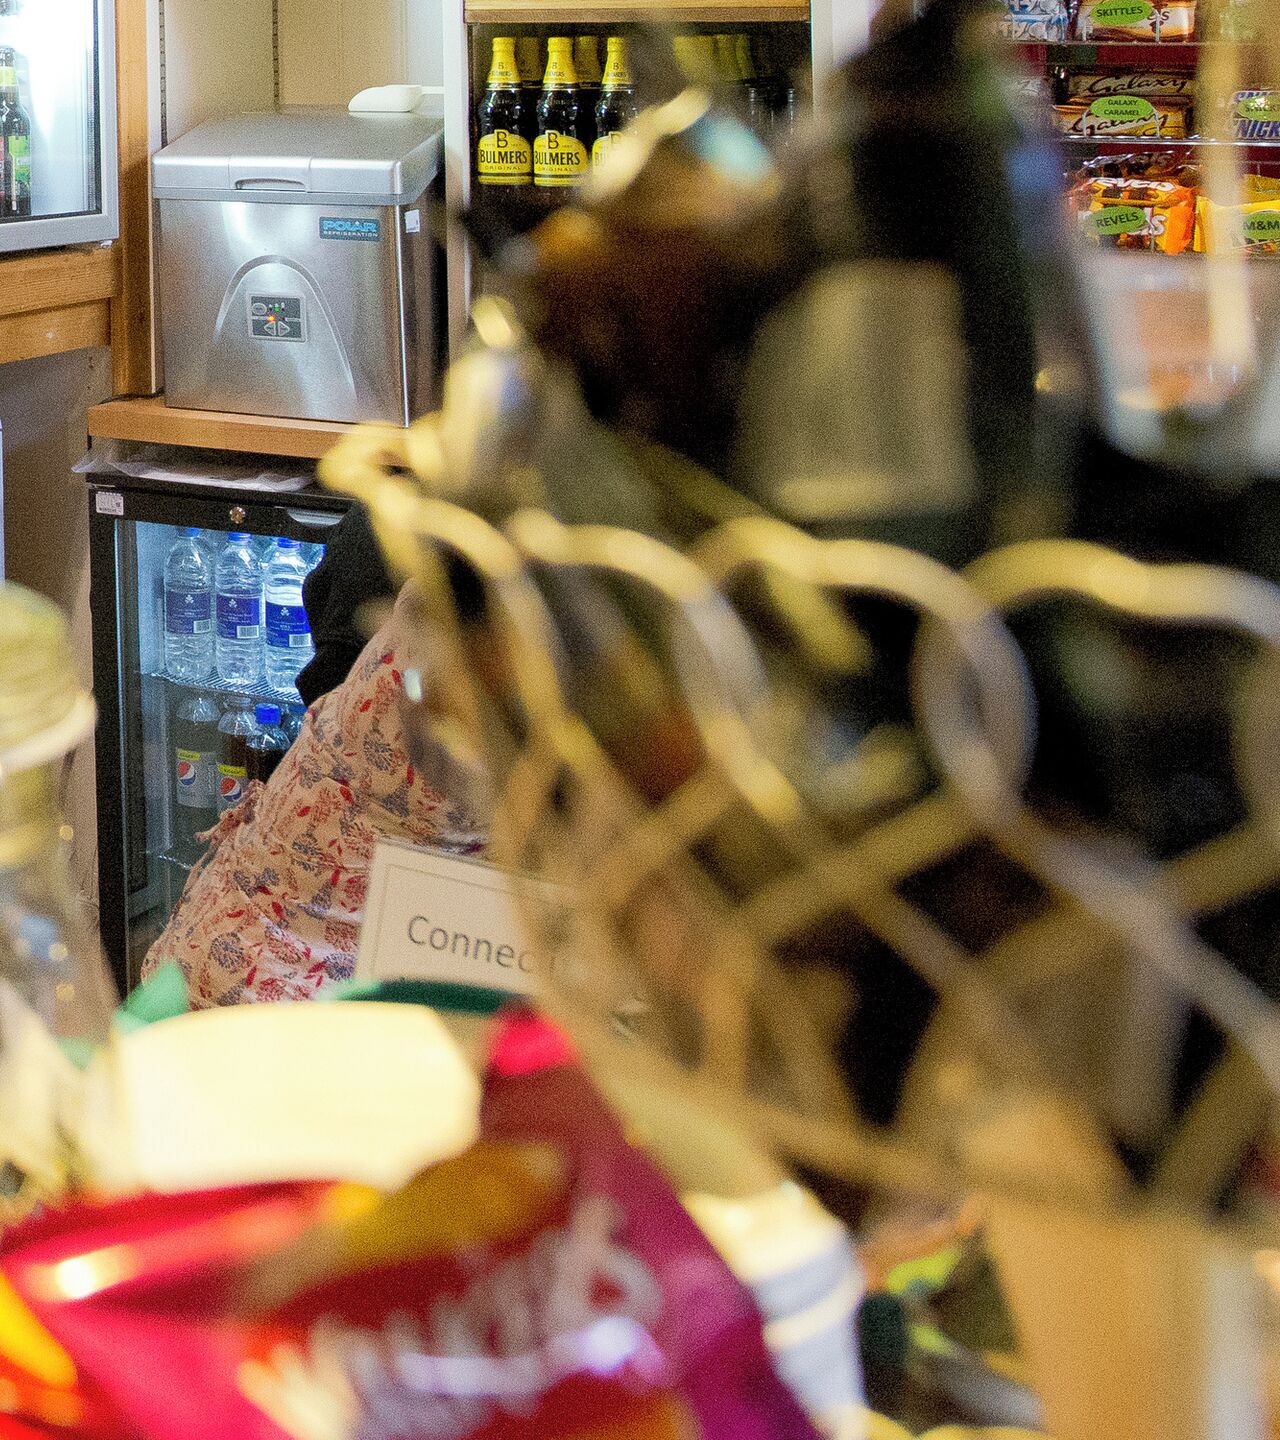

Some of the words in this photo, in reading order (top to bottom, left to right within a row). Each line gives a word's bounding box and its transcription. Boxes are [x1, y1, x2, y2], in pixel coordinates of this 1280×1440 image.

[1096, 7, 1144, 18] SKITTLES
[1087, 75, 1188, 94] Galaxy
[480, 150, 528, 164] BULMERS
[534, 151, 581, 165] BULMERS
[322, 220, 377, 231] POLAR
[1096, 212, 1139, 228] REVELS
[407, 914, 535, 973] Connec
